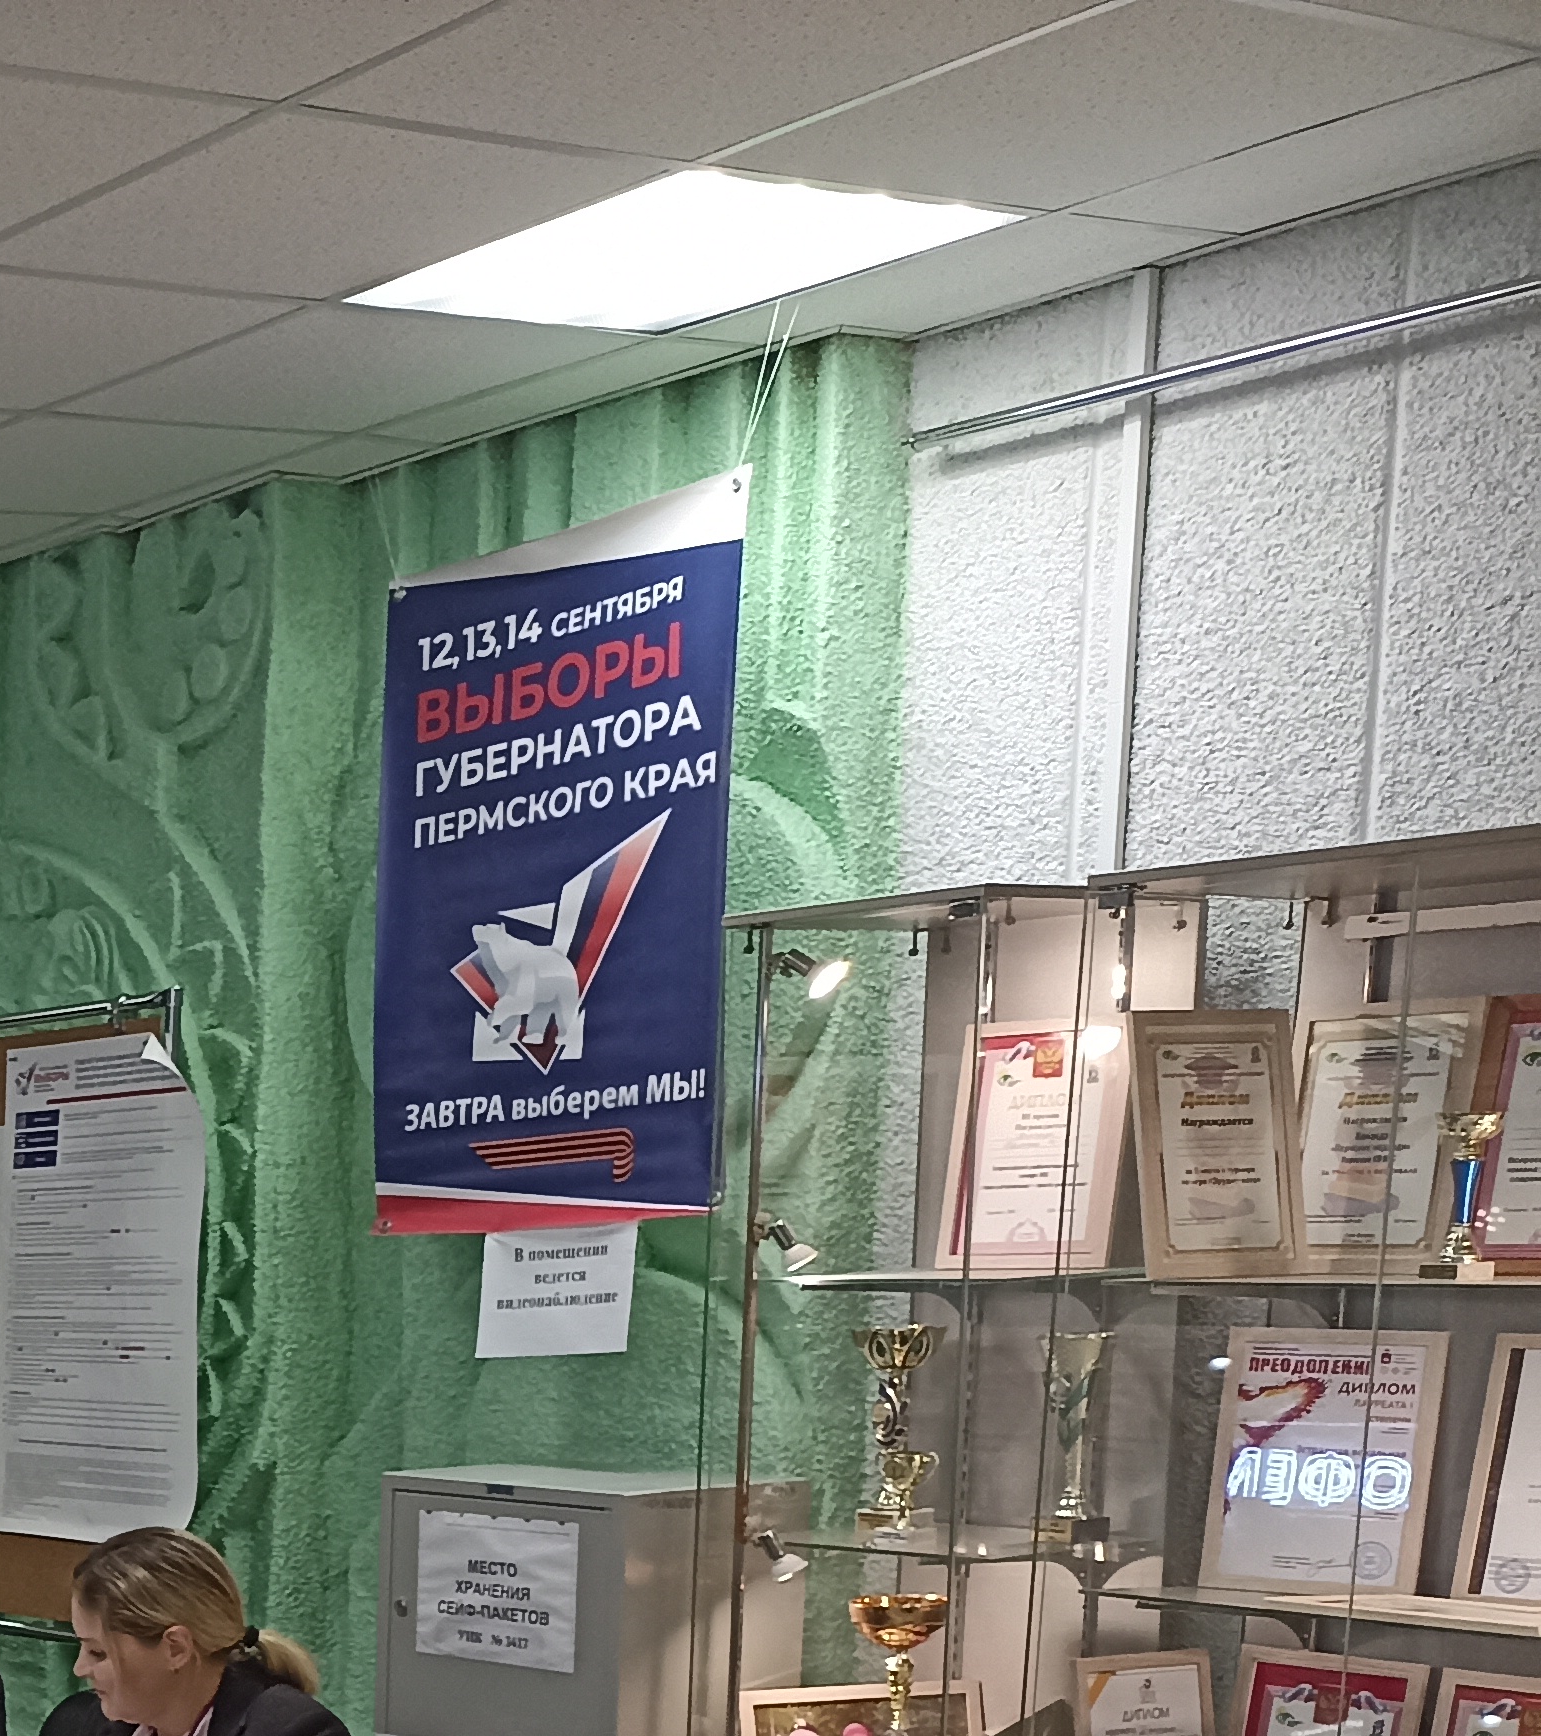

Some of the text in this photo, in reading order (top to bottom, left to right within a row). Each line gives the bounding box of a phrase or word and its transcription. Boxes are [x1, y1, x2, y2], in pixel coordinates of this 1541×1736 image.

[418, 575, 684, 671] 12,13,14 СЕНТЯБРЯ
[417, 621, 681, 743] ВЫБОРЫ
[415, 694, 702, 797] ГУБЕРНАТОРА
[414, 750, 716, 848] ПЕРМСКОГО КРАЯ
[404, 1068, 706, 1132] ЗАВТРА выберем МЫ!
[514, 1244, 609, 1263] В помещении
[496, 1290, 619, 1310] видеонаблюдение
[455, 1580, 530, 1601] ХРАНЕНИЯ
[467, 1559, 518, 1577] МЕСТО
[437, 1599, 549, 1626] СЕЙФ-ПАКЕТОВ
